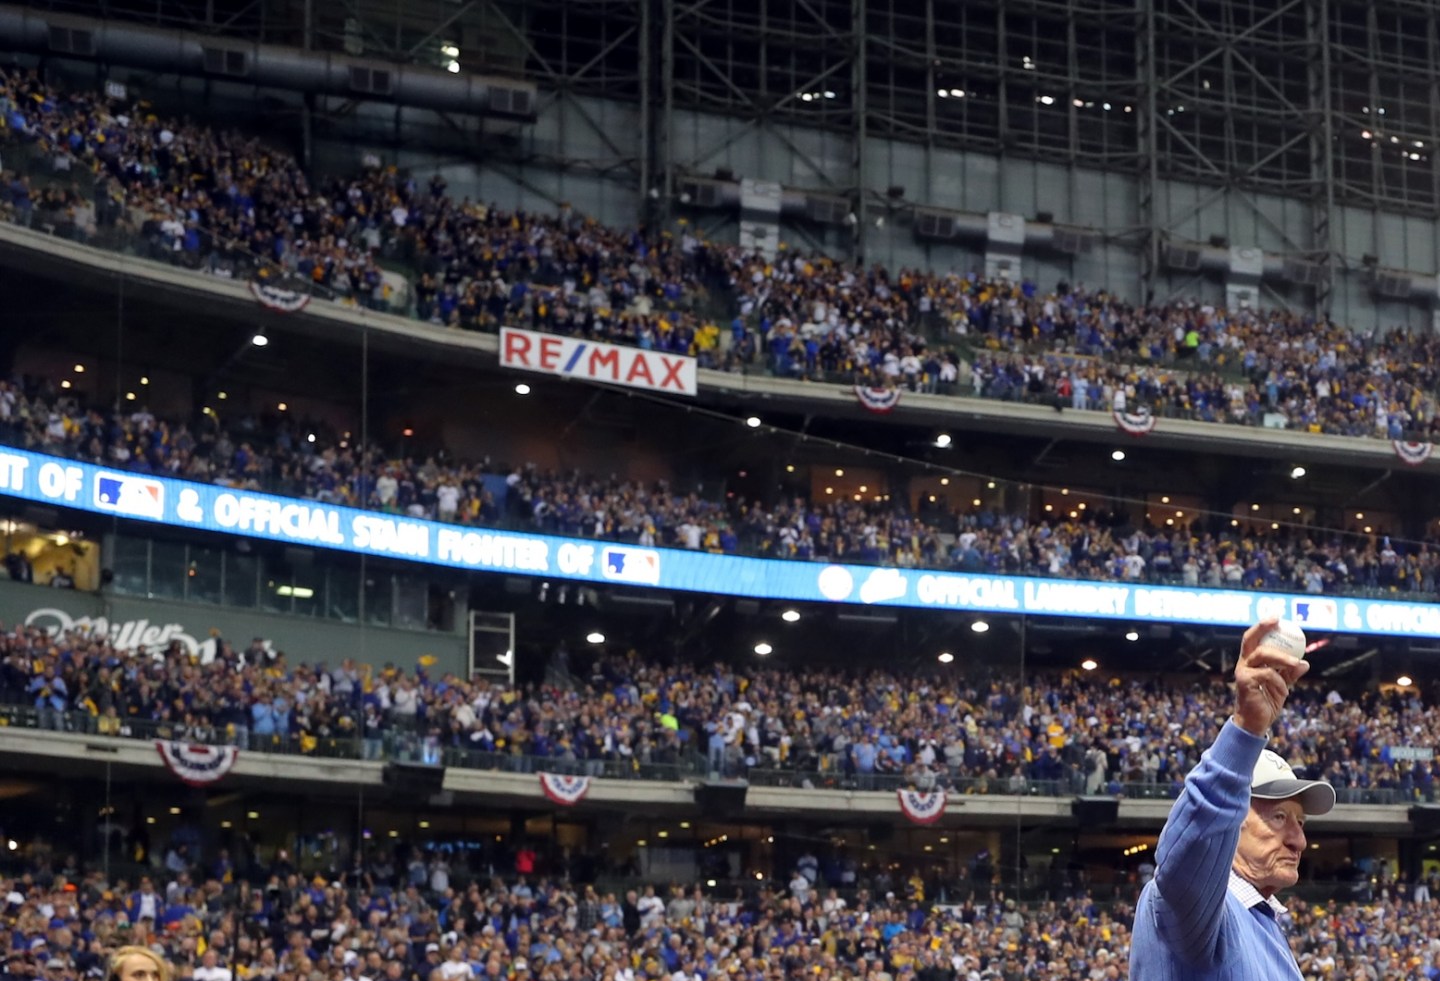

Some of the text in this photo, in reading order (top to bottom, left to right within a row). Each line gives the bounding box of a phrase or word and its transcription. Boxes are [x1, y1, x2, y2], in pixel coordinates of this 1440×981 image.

[504, 331, 686, 391] RE/MAX
[38, 463, 84, 501] OF
[176, 488, 204, 523] &
[214, 493, 345, 545] OFFICIAL
[352, 515, 429, 556] STAIN
[438, 528, 550, 572] FIGHTER
[557, 542, 594, 576] OF
[917, 574, 1019, 609] OFFICIAL
